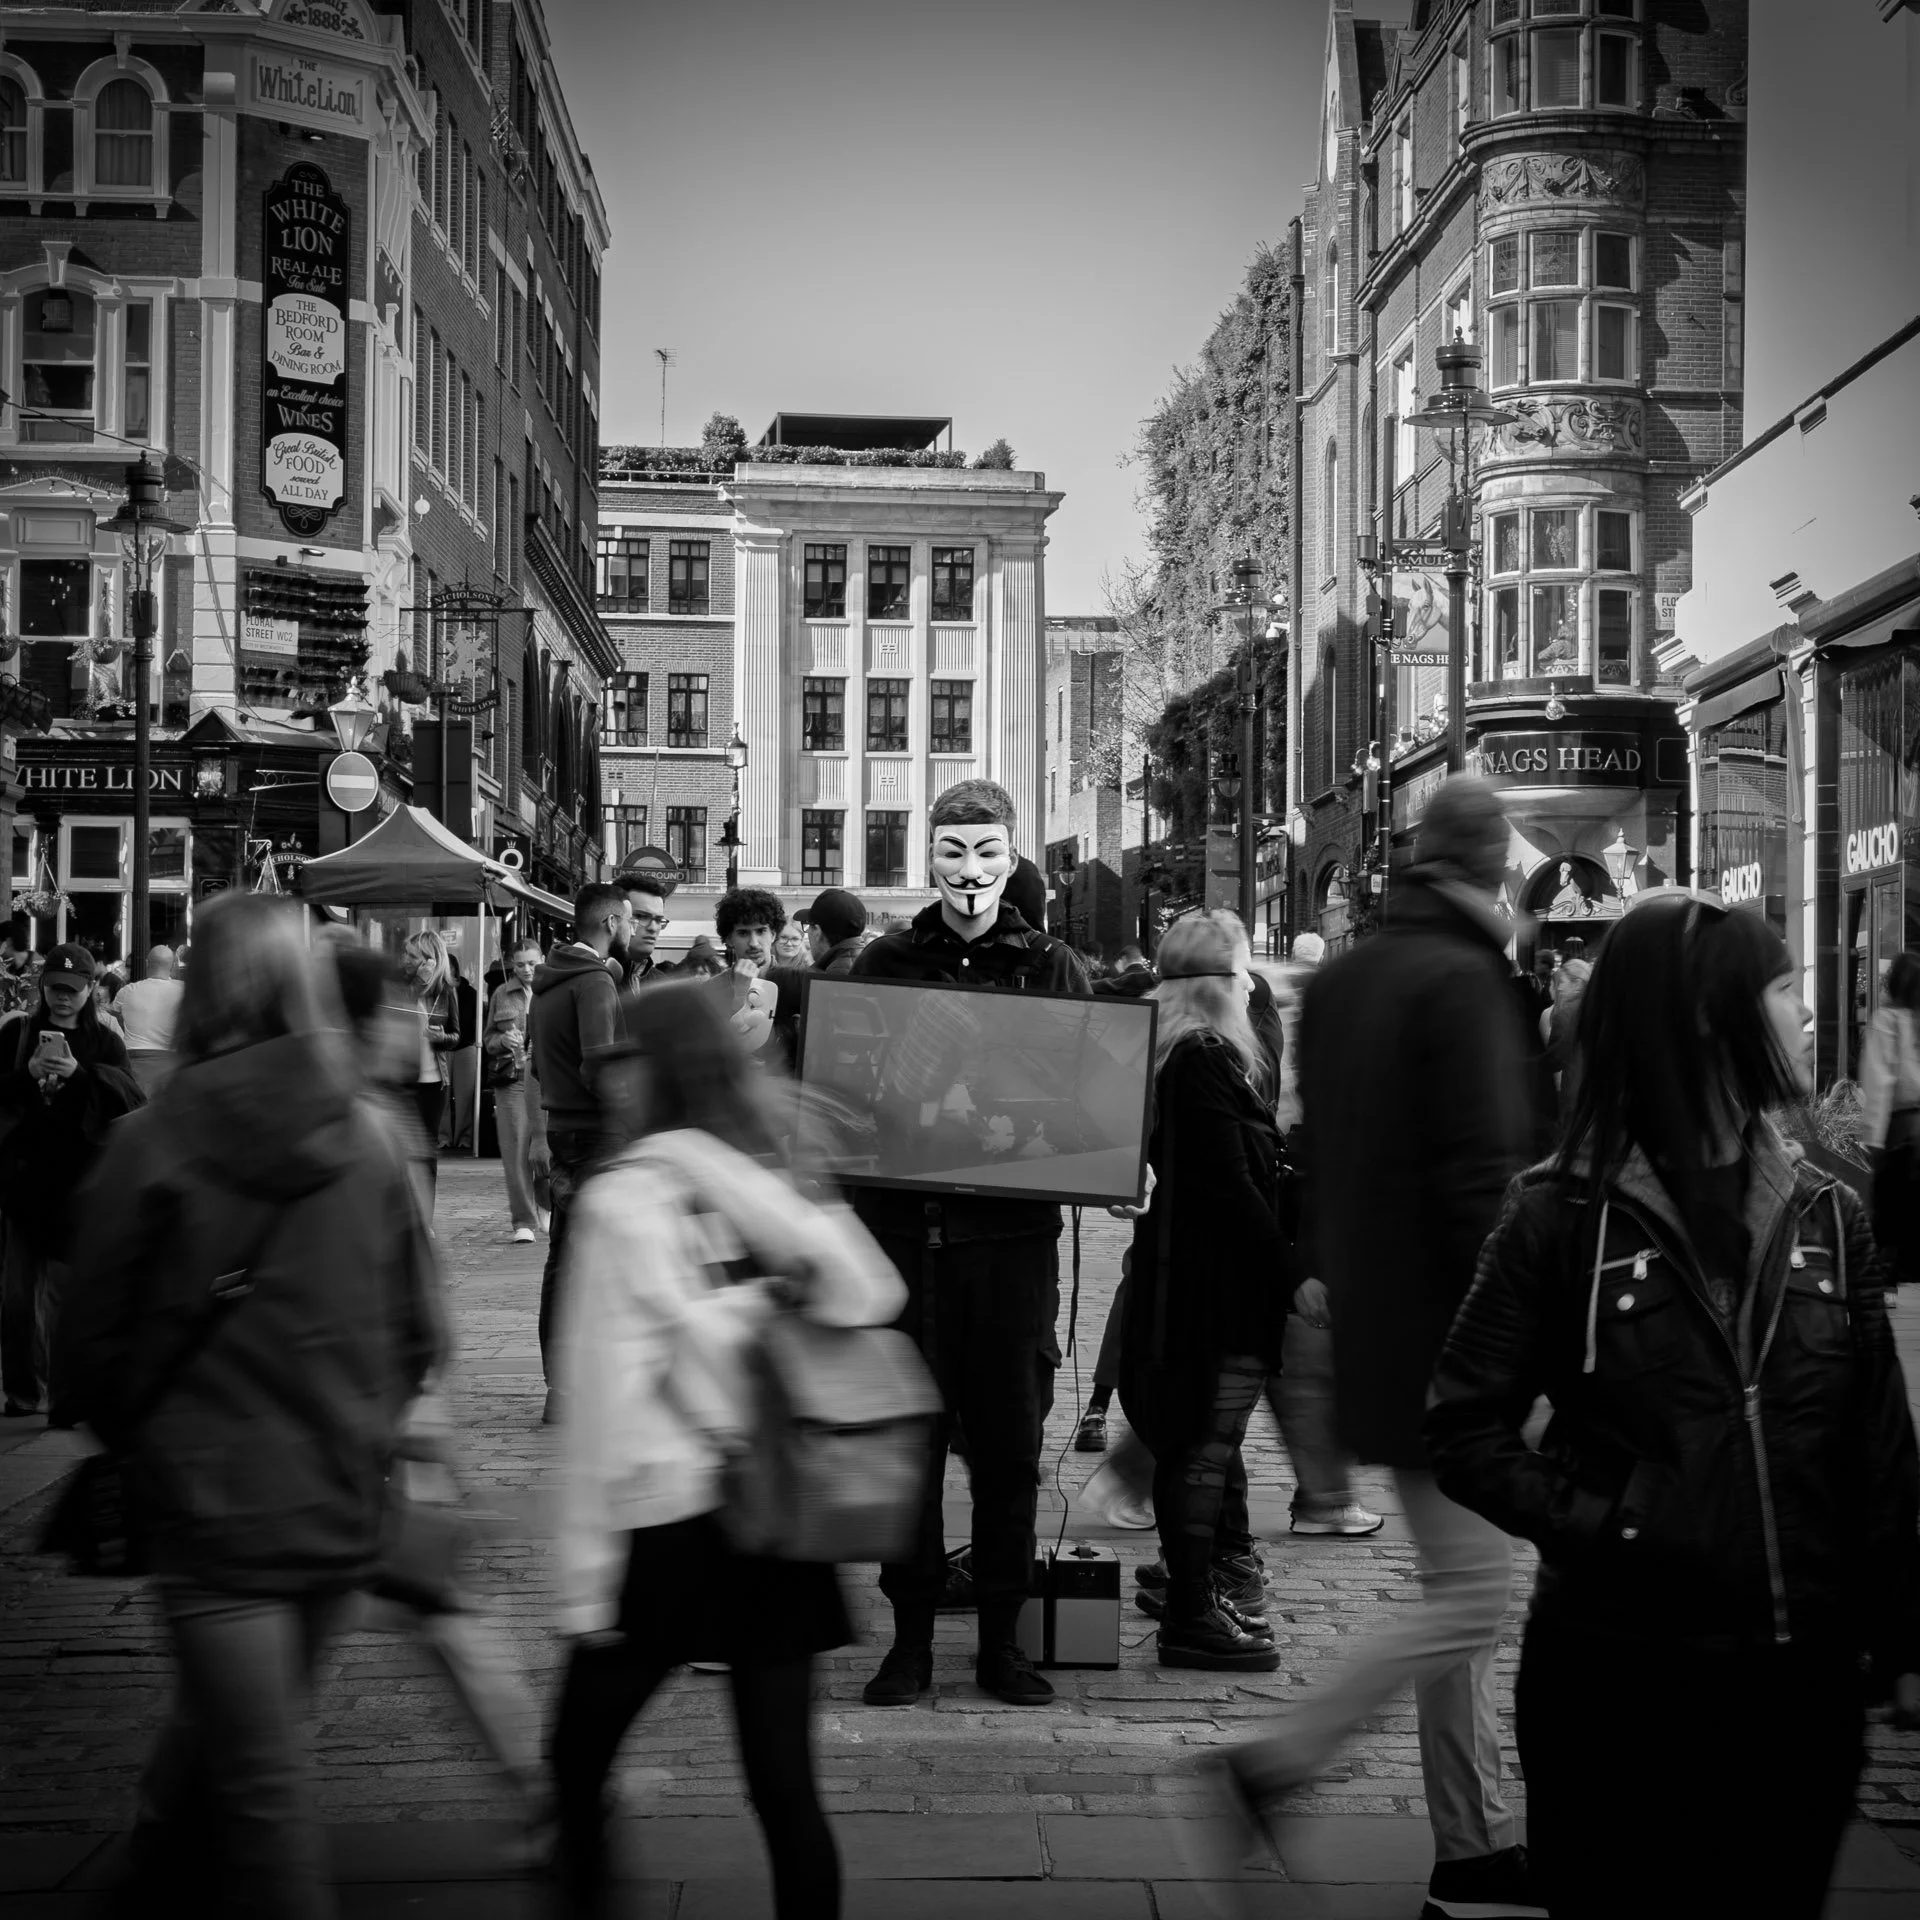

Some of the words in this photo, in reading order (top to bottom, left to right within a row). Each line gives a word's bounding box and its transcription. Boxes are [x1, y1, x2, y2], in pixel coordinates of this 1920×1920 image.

[308, 7, 341, 32] 1888
[299, 60, 318, 72] THE
[292, 179, 325, 198] THE
[270, 199, 345, 235] WHITE
[281, 226, 333, 256] LION
[271, 256, 309, 279] REAL
[312, 264, 343, 286] ALE
[296, 300, 317, 313] THE
[275, 308, 338, 334] BEDFORD
[285, 325, 325, 344] ROOM
[271, 350, 308, 374] DINING
[310, 359, 342, 375] ROOM
[287, 342, 312, 358] Bar
[313, 346, 325, 360] &
[266, 388, 280, 398] an
[280, 384, 319, 403] Excellent
[318, 392, 345, 408] choice
[277, 403, 335, 433] WINES
[273, 440, 301, 466] Great
[301, 441, 338, 470] British
[286, 455, 325, 474] FOOD
[281, 484, 303, 497] ALL
[305, 487, 329, 500] DAY
[434, 590, 499, 604] NICHOLSON'S
[246, 627, 274, 640] STREET
[277, 631, 293, 642] WC2
[1402, 654, 1434, 664] NAGS
[1484, 747, 1549, 775] NAGS
[1557, 747, 1642, 772] HEAD
[1847, 822, 1898, 873] GAUCHO
[1721, 861, 1762, 905] GAUCHO
